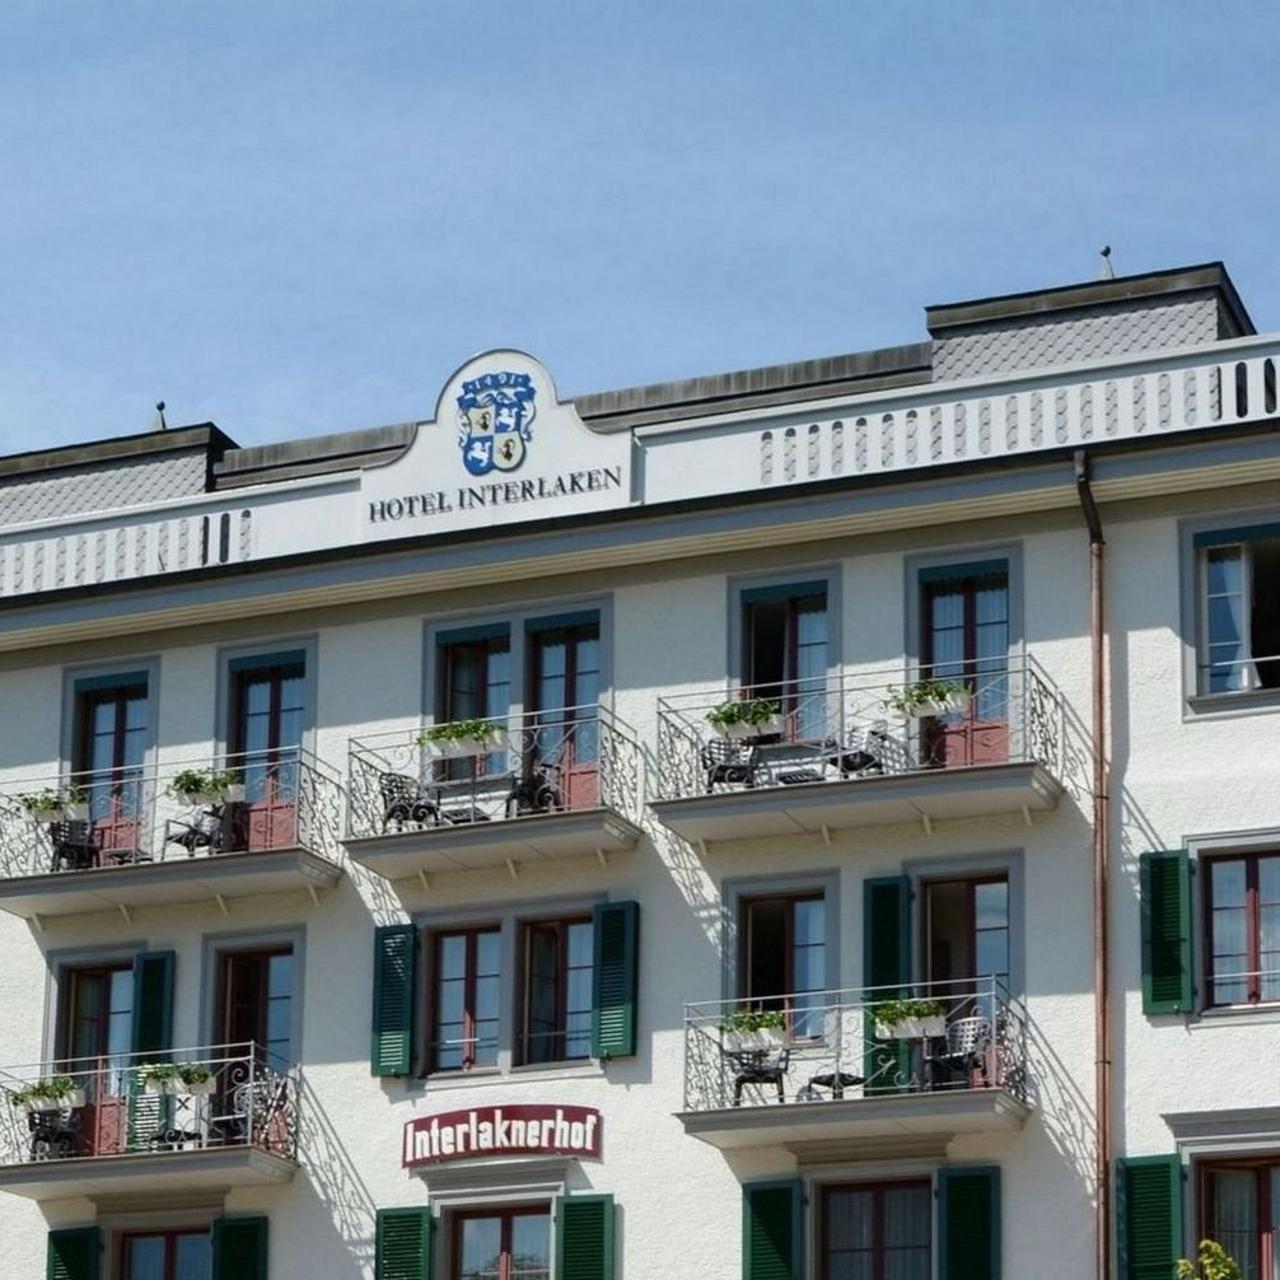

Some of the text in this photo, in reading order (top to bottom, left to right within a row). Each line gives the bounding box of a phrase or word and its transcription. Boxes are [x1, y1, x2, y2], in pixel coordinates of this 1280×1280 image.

[369, 466, 622, 523] HOTEL INTERLAKEN
[405, 1109, 597, 1163] Interlaknerhof
